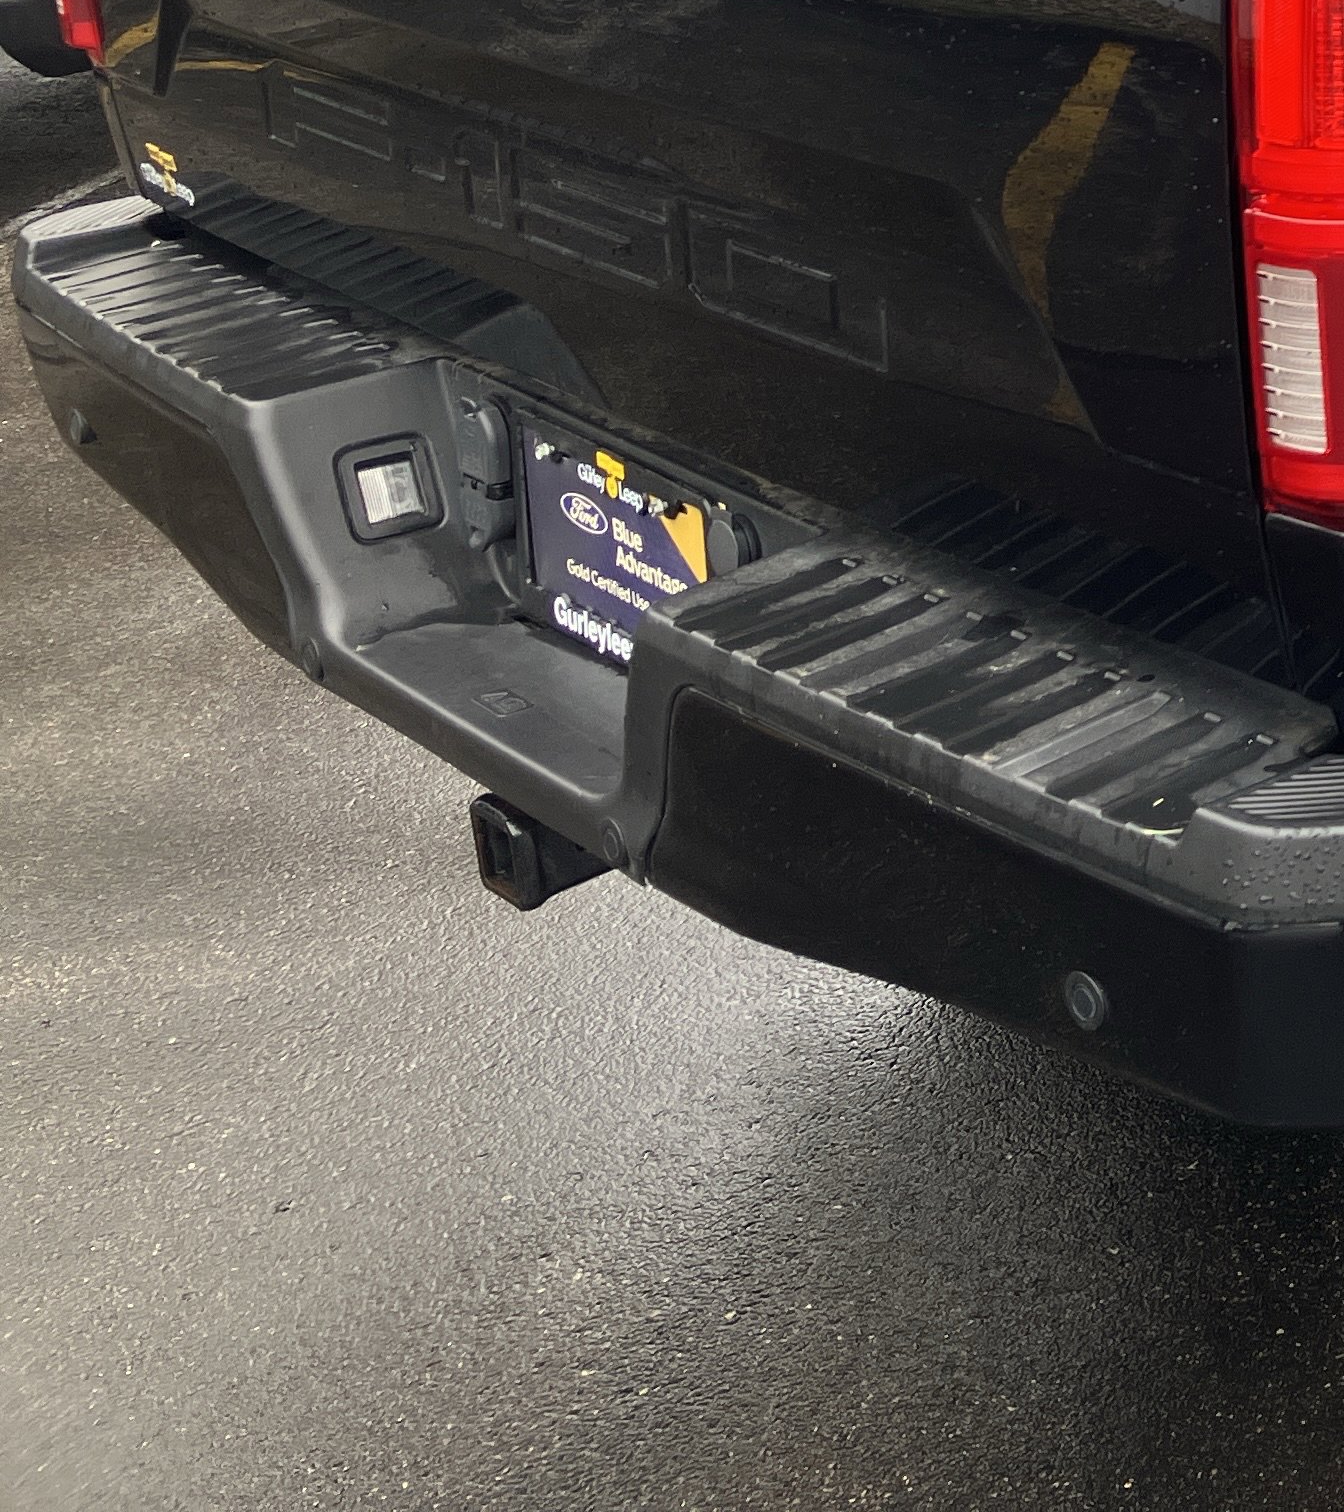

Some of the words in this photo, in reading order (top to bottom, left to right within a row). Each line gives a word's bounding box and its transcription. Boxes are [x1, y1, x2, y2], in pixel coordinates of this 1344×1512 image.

[612, 517, 643, 552] Blue
[566, 558, 590, 582] Gold
[591, 570, 632, 604] Certified
[553, 596, 634, 661] Gurleylee
